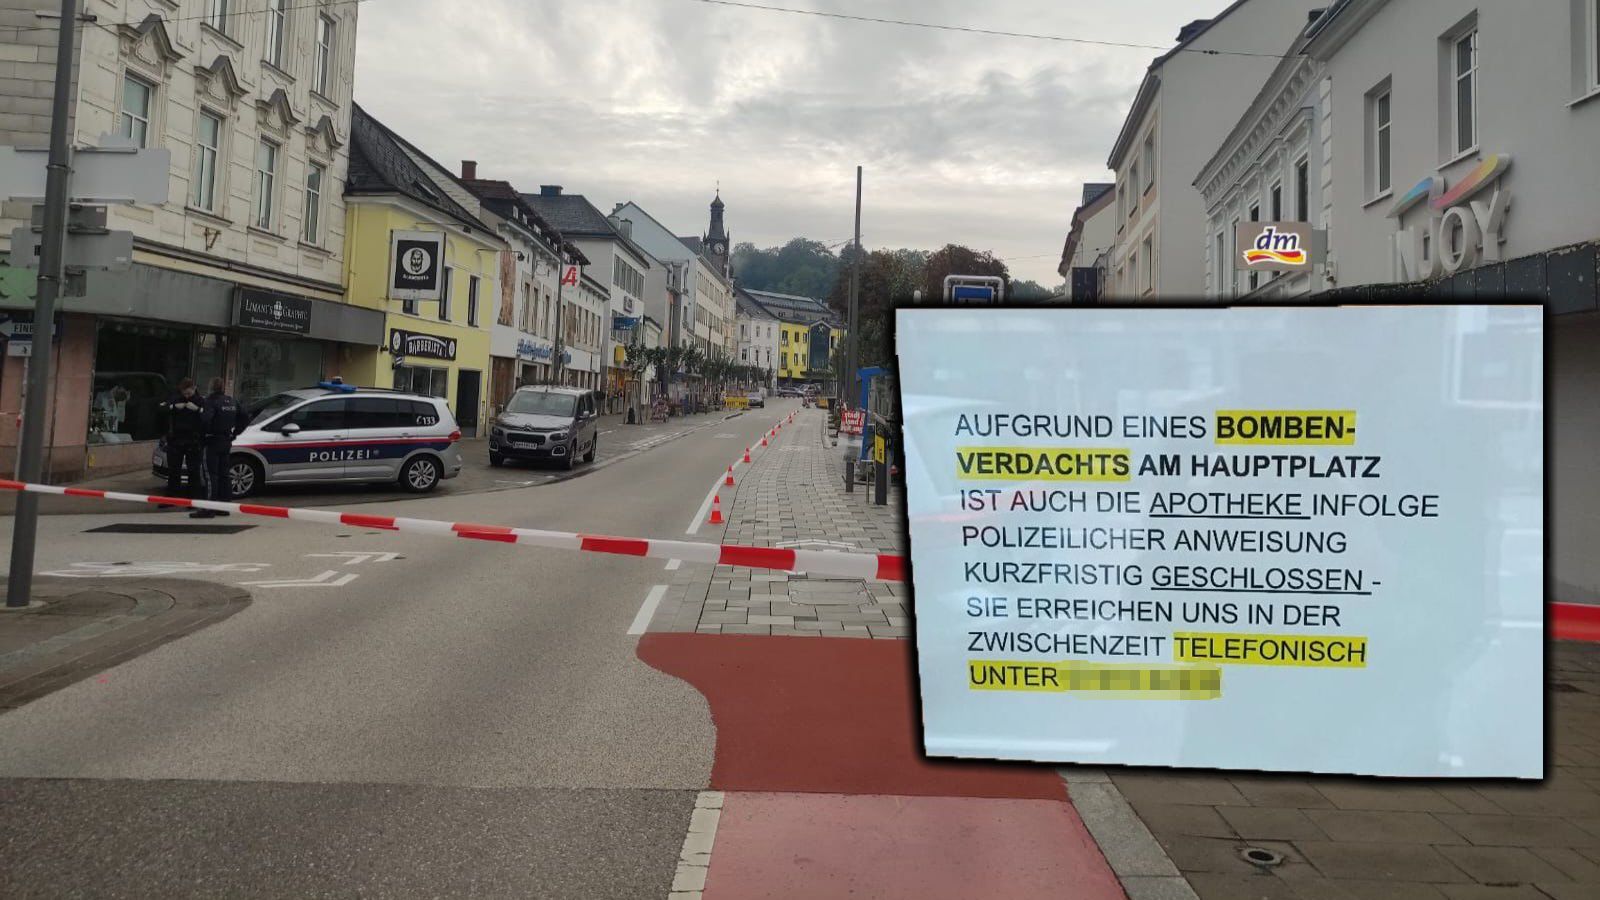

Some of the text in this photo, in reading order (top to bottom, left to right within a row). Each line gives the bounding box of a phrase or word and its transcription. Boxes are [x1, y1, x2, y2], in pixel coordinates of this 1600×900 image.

[1256, 227, 1298, 250] dm
[408, 339, 443, 357] BARBERISTA
[422, 416, 436, 425] 133
[955, 414, 1356, 439] AUFGRUND EINES BOMBEN-
[309, 449, 370, 462] POLIZEI
[956, 452, 1382, 478] VERDACHTS AM HAUPTPLATZ
[961, 489, 1440, 518] IST AUCH DIE APOTHEKE INFOLGE
[962, 525, 1348, 554] POLIZEILICHER ANWEISUNG
[964, 562, 1142, 587] KURZFRISTIG
[1152, 565, 1364, 592] GESCHLOSSEN
[966, 597, 1342, 627] SIE ERREICHEN UNS IN DER
[967, 631, 1367, 663] ZWISCHENZEIT TELEFONISCH
[969, 664, 1060, 688] UNTER
